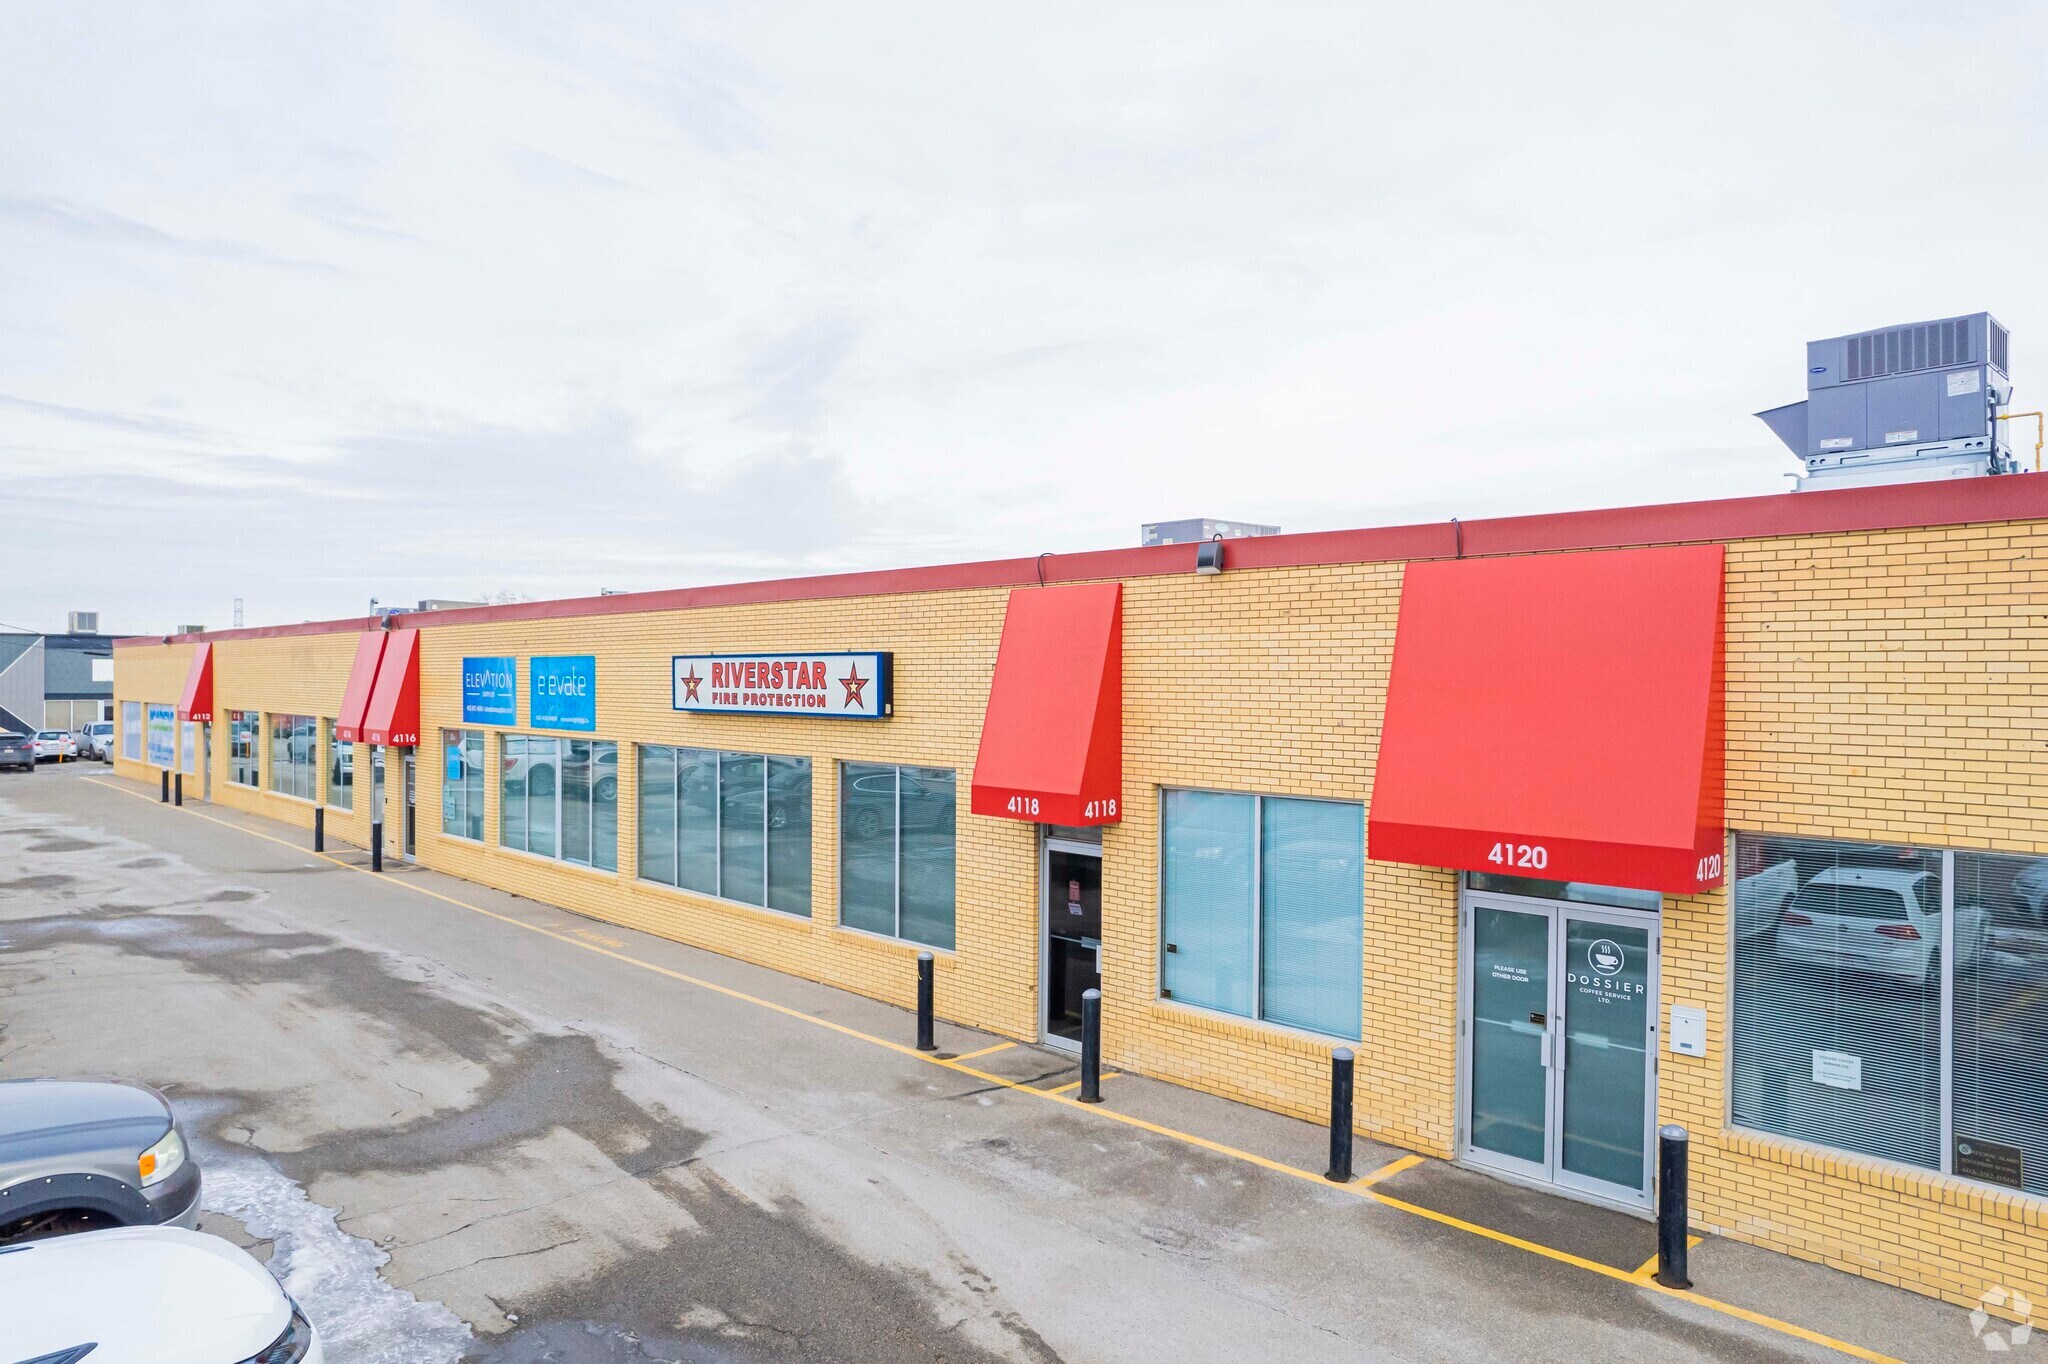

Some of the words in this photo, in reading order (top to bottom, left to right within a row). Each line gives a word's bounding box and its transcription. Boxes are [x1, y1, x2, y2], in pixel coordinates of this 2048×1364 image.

[466, 669, 512, 688] ELEVATION
[537, 666, 586, 697] eevate
[711, 661, 827, 689] RIVERSTAR
[712, 692, 738, 705] FIRE
[743, 692, 826, 708] PROTECTION
[393, 733, 417, 743] 4116
[1007, 796, 1039, 815] 4118
[1084, 799, 1117, 818] 4118
[1488, 842, 1548, 869] 4120
[1696, 854, 1721, 882] 4120
[1491, 971, 1511, 980] OTHER
[1511, 975, 1529, 983] DOOR
[1493, 964, 1515, 973] PLEASE
[1567, 972, 1644, 994] DOSSIER
[1579, 987, 1603, 996] COFFEE
[1604, 991, 1631, 1001] SERVICE
